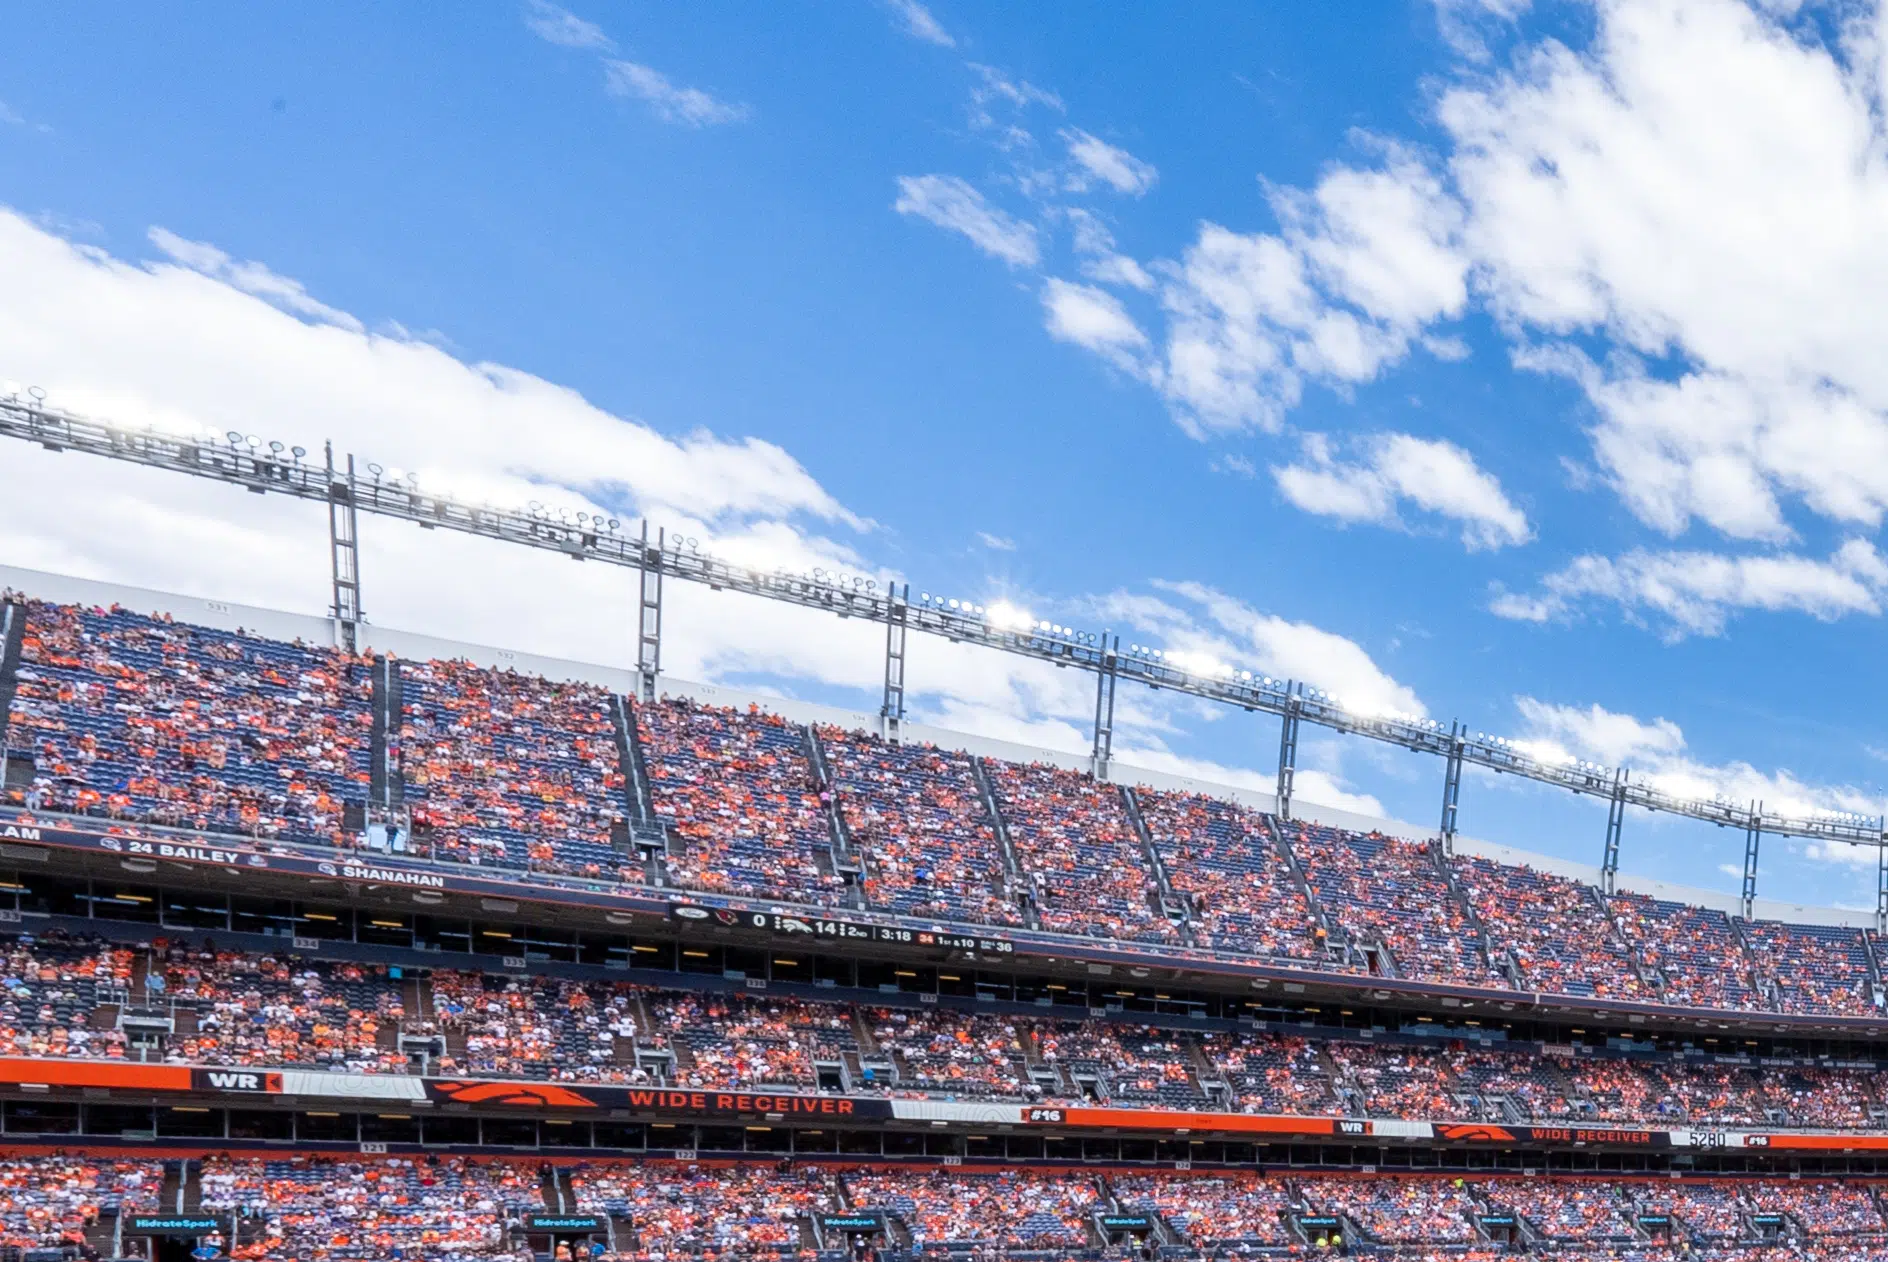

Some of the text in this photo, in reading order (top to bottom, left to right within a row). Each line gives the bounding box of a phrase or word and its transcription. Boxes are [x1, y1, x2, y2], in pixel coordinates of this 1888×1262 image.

[0, 824, 41, 842] AM
[129, 841, 238, 864] 24 BAILEY
[343, 866, 444, 887] SHANAHAN
[753, 914, 766, 927] 0
[815, 921, 836, 934] 14
[881, 928, 912, 942] 3:18
[960, 936, 975, 948] 10
[996, 941, 1013, 952] 36
[208, 1072, 259, 1090] WR
[629, 1090, 854, 1115] WIDE RECEIVER
[1029, 1108, 1061, 1122] #16
[1340, 1121, 1363, 1134] WR
[1531, 1128, 1650, 1144] WIDE RECEIVER
[1689, 1133, 1726, 1148] 5280
[1748, 1135, 1768, 1147] #16
[136, 1218, 218, 1231] HidrateSpark
[533, 1217, 597, 1229] HidrateSpark
[824, 1217, 876, 1228] HidrateSpark
